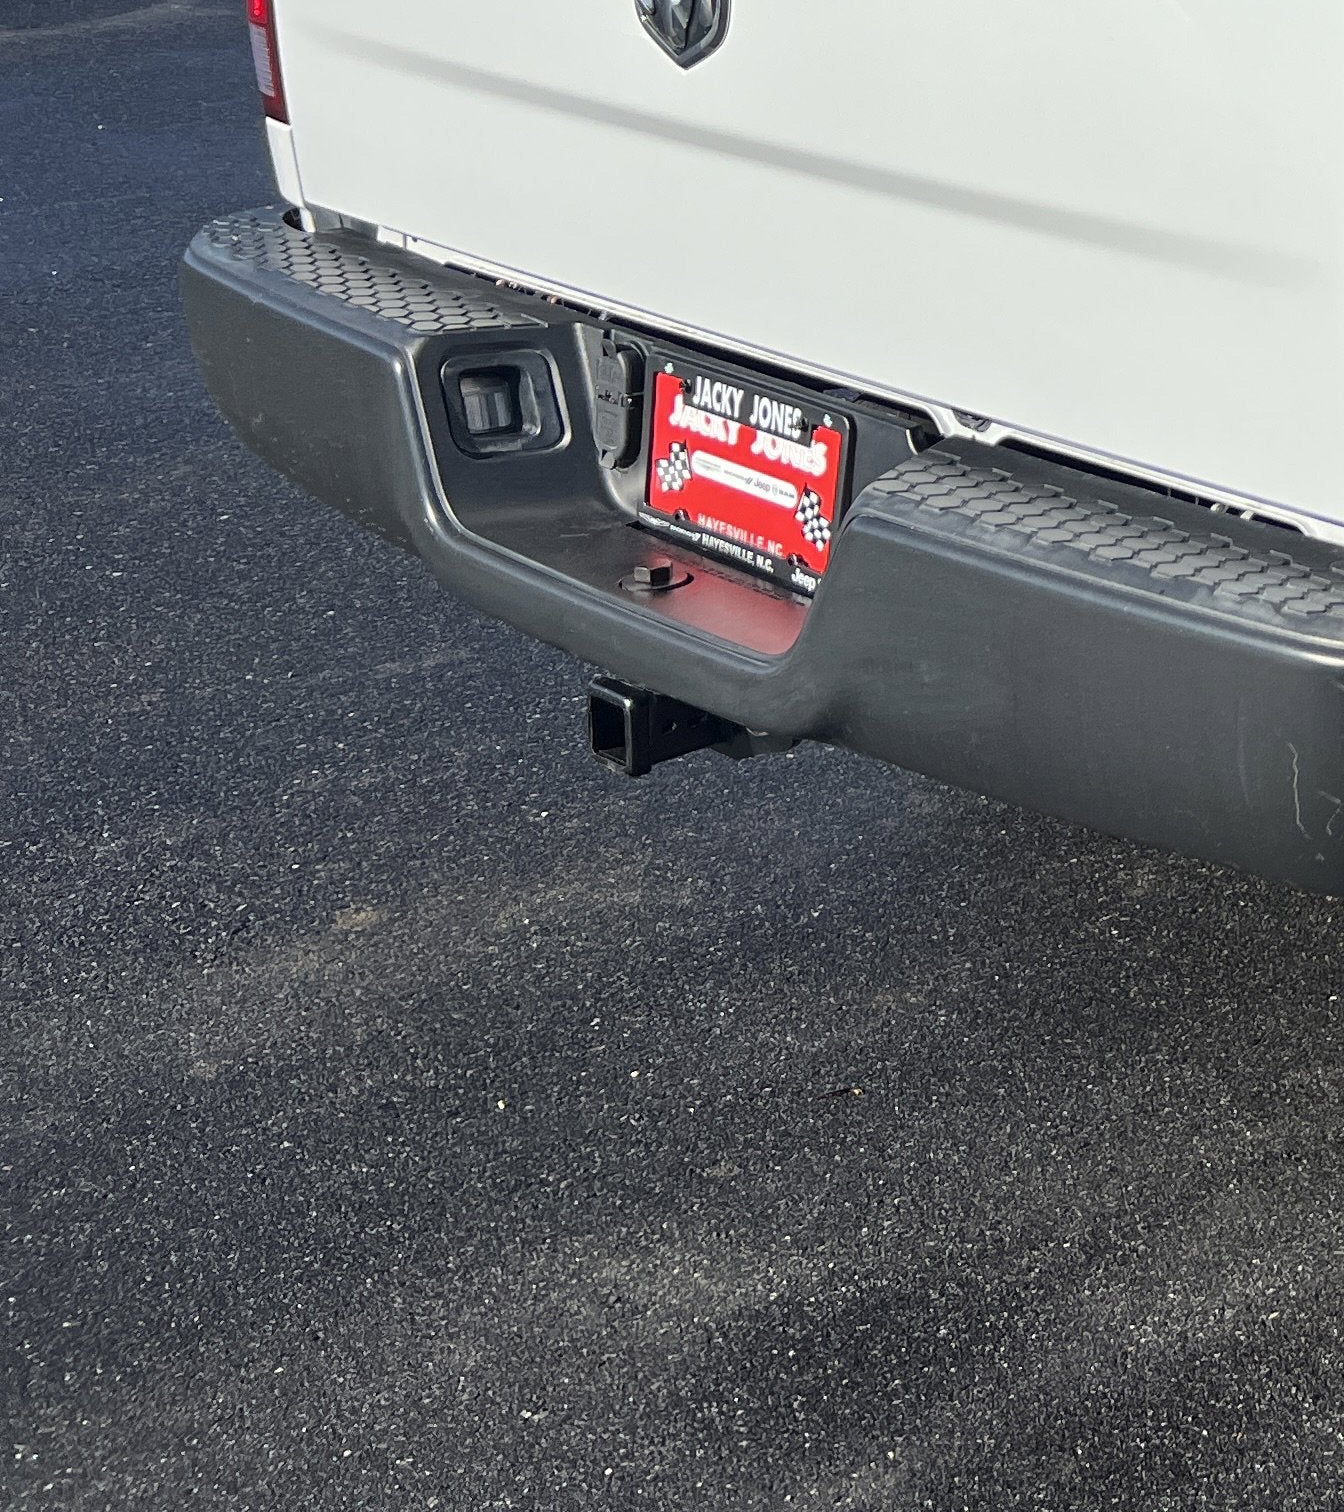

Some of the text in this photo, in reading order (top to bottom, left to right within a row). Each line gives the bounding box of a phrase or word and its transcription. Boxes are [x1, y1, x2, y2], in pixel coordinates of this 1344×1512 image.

[692, 375, 802, 440] JACKY JONES
[790, 567, 817, 591] Jeep
